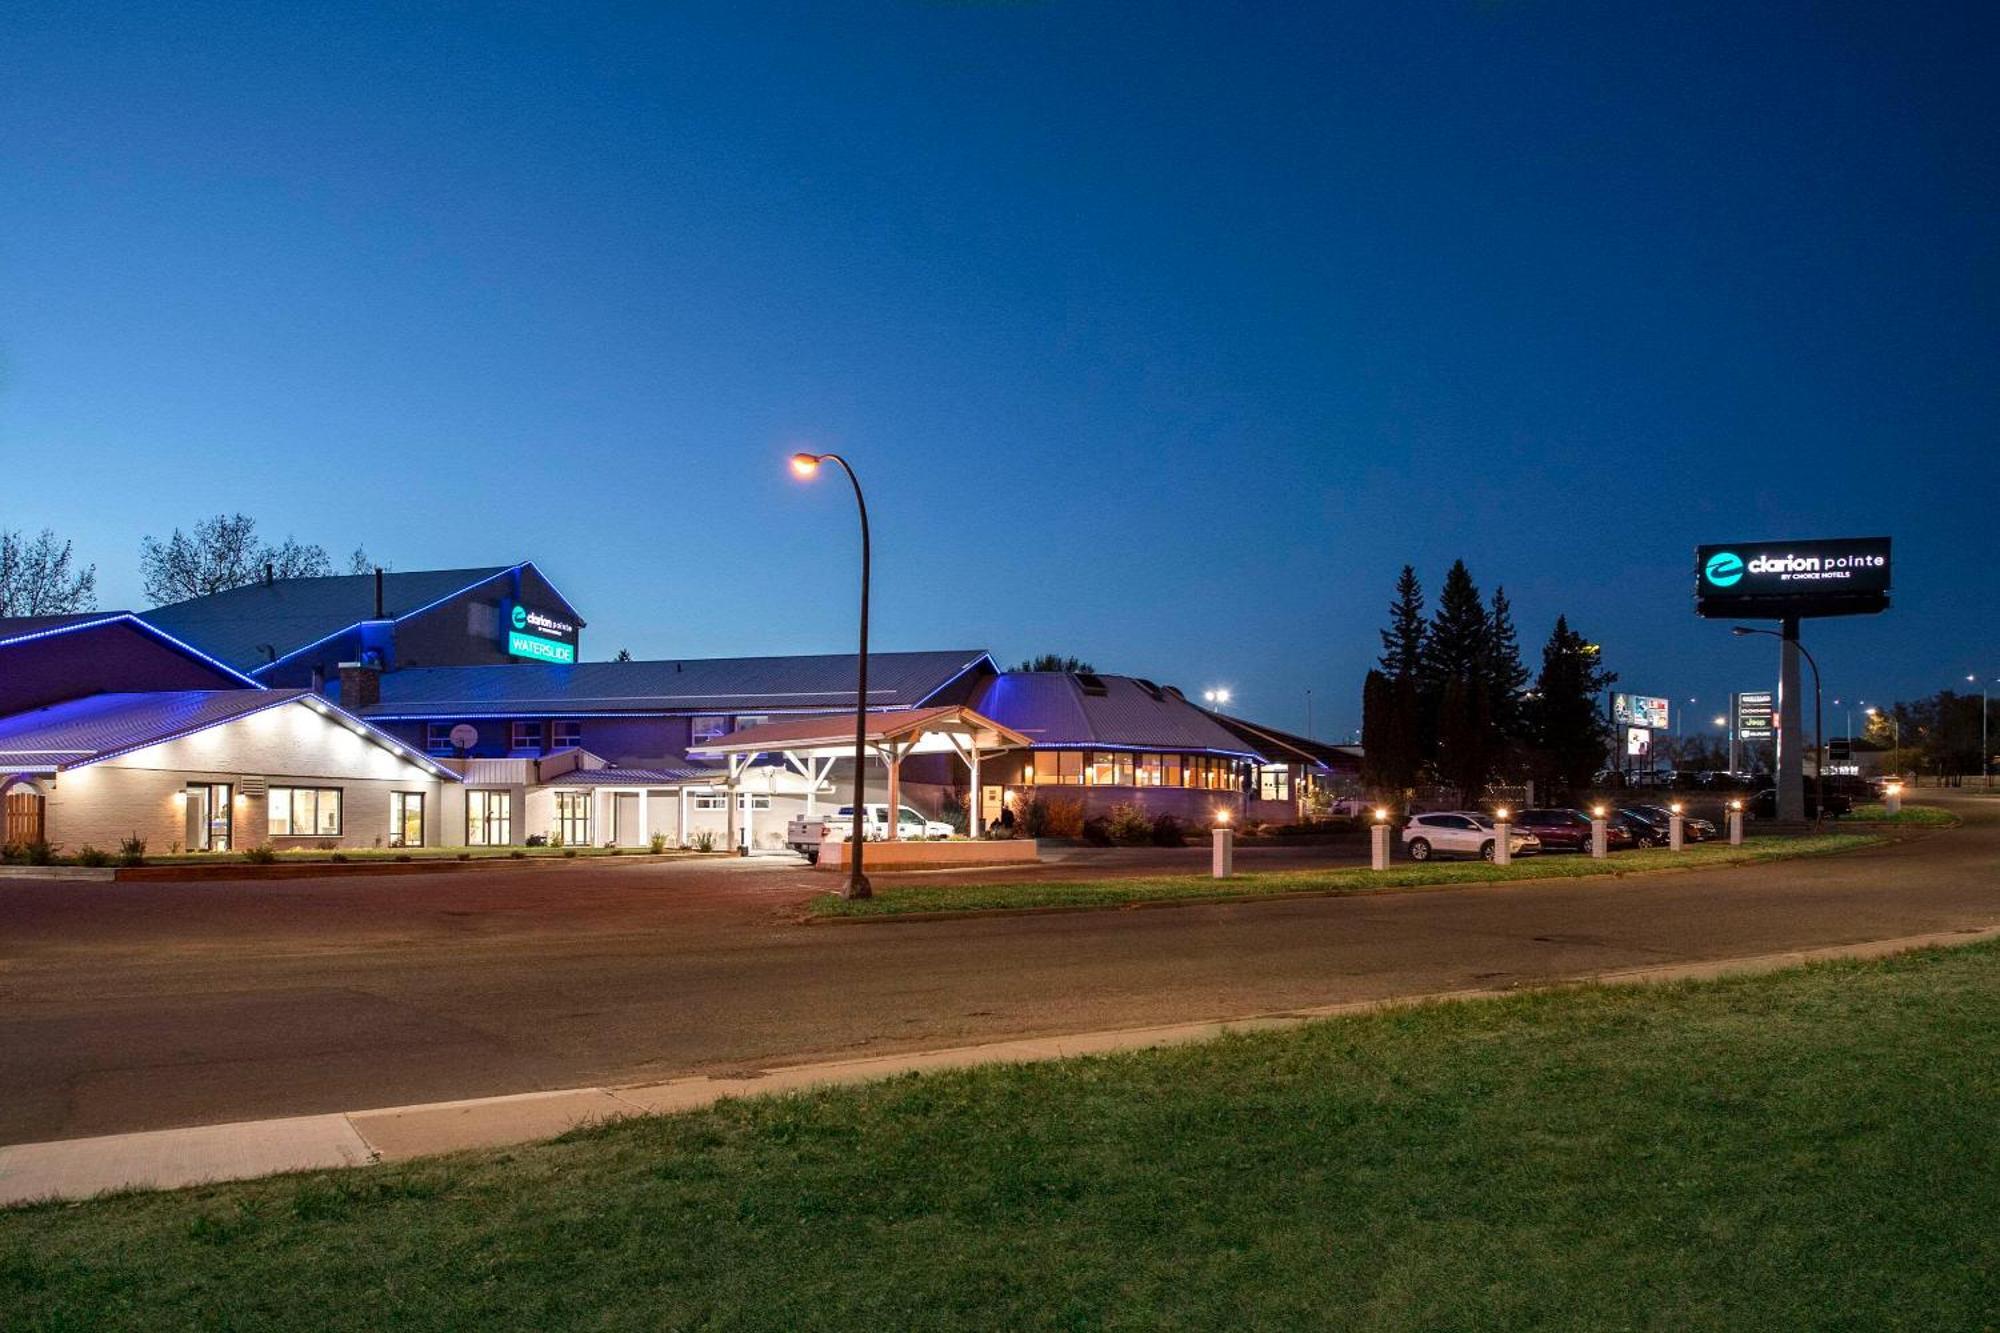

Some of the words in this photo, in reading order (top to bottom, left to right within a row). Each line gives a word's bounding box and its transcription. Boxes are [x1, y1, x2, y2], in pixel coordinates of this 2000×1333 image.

[1748, 555, 1819, 573] clarion
[1824, 555, 1884, 570] pointe
[513, 638, 571, 660] WATERSLIDE
